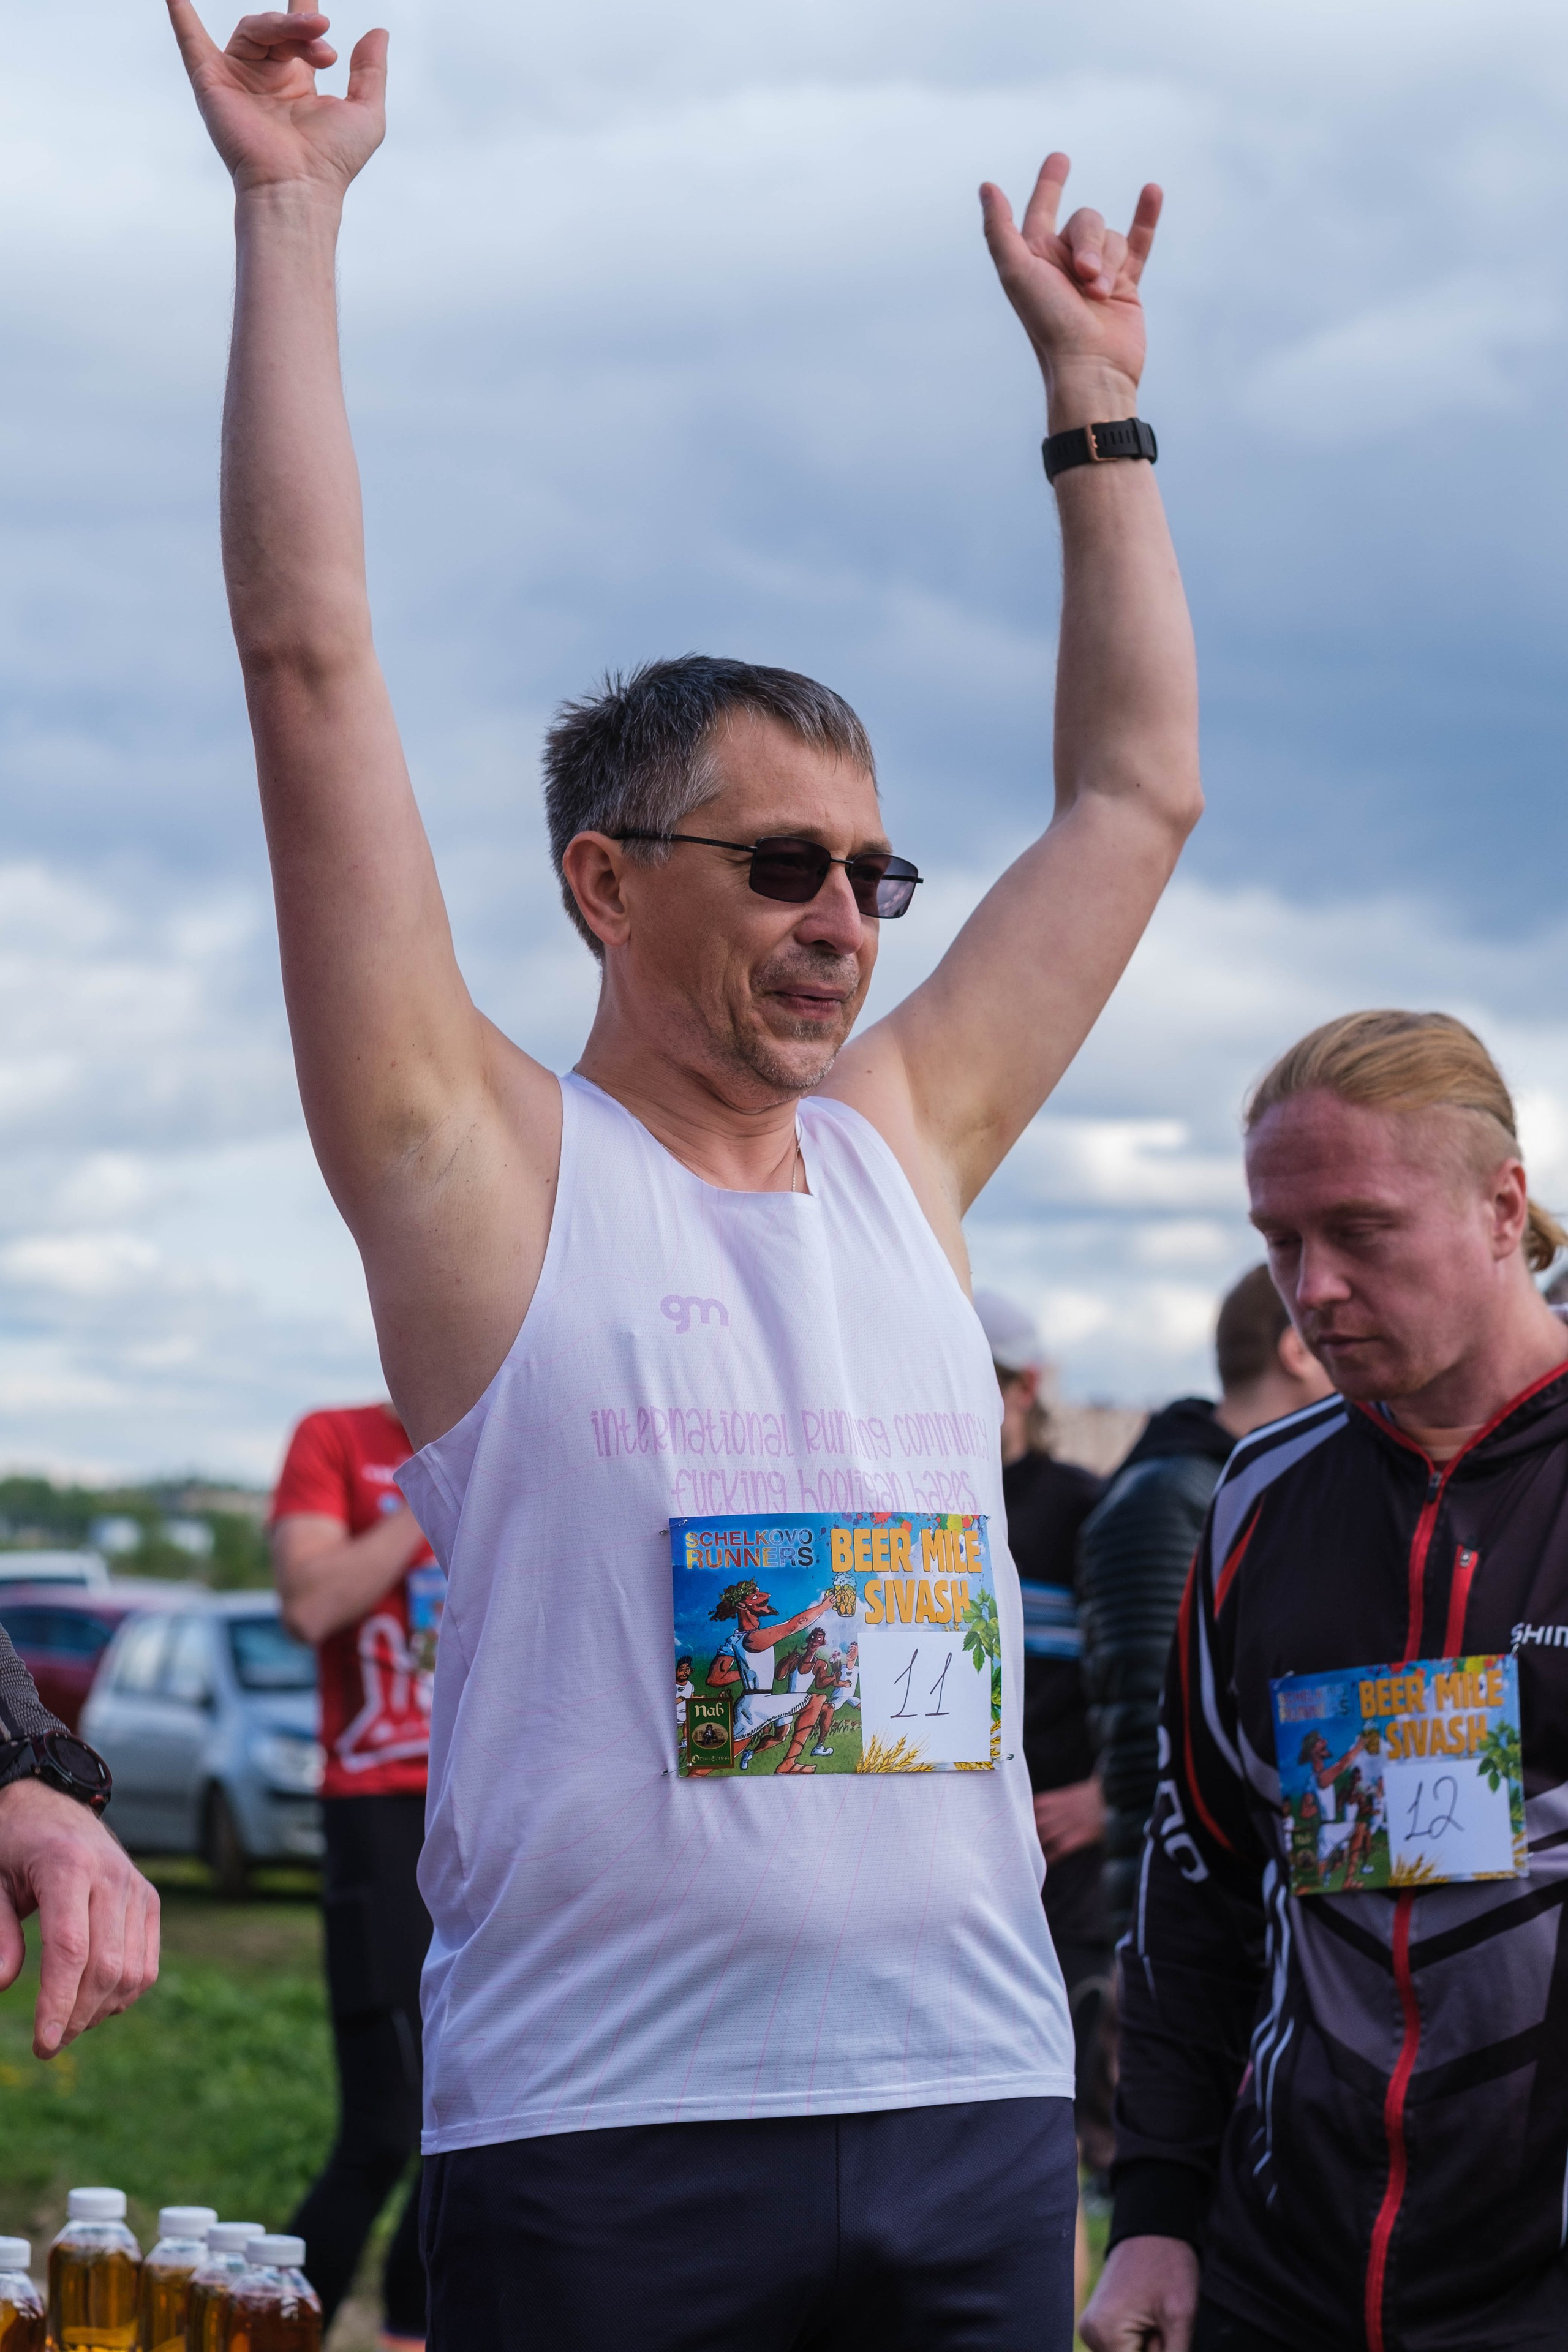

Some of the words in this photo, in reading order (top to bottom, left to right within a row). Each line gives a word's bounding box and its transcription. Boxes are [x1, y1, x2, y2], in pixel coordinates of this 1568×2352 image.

[685, 1529, 813, 1548] SCHELKOVO
[686, 1547, 813, 1569] RUNNERS
[831, 1528, 914, 1573] BEER
[922, 1528, 982, 1573] MILE
[864, 1579, 971, 1624] SIVASH
[890, 1648, 949, 1719] 11
[1359, 1675, 1426, 1719] BEER
[1435, 1670, 1504, 1712] MILE
[1385, 1714, 1488, 1760] SIVASH
[1404, 1776, 1464, 1842] 12
